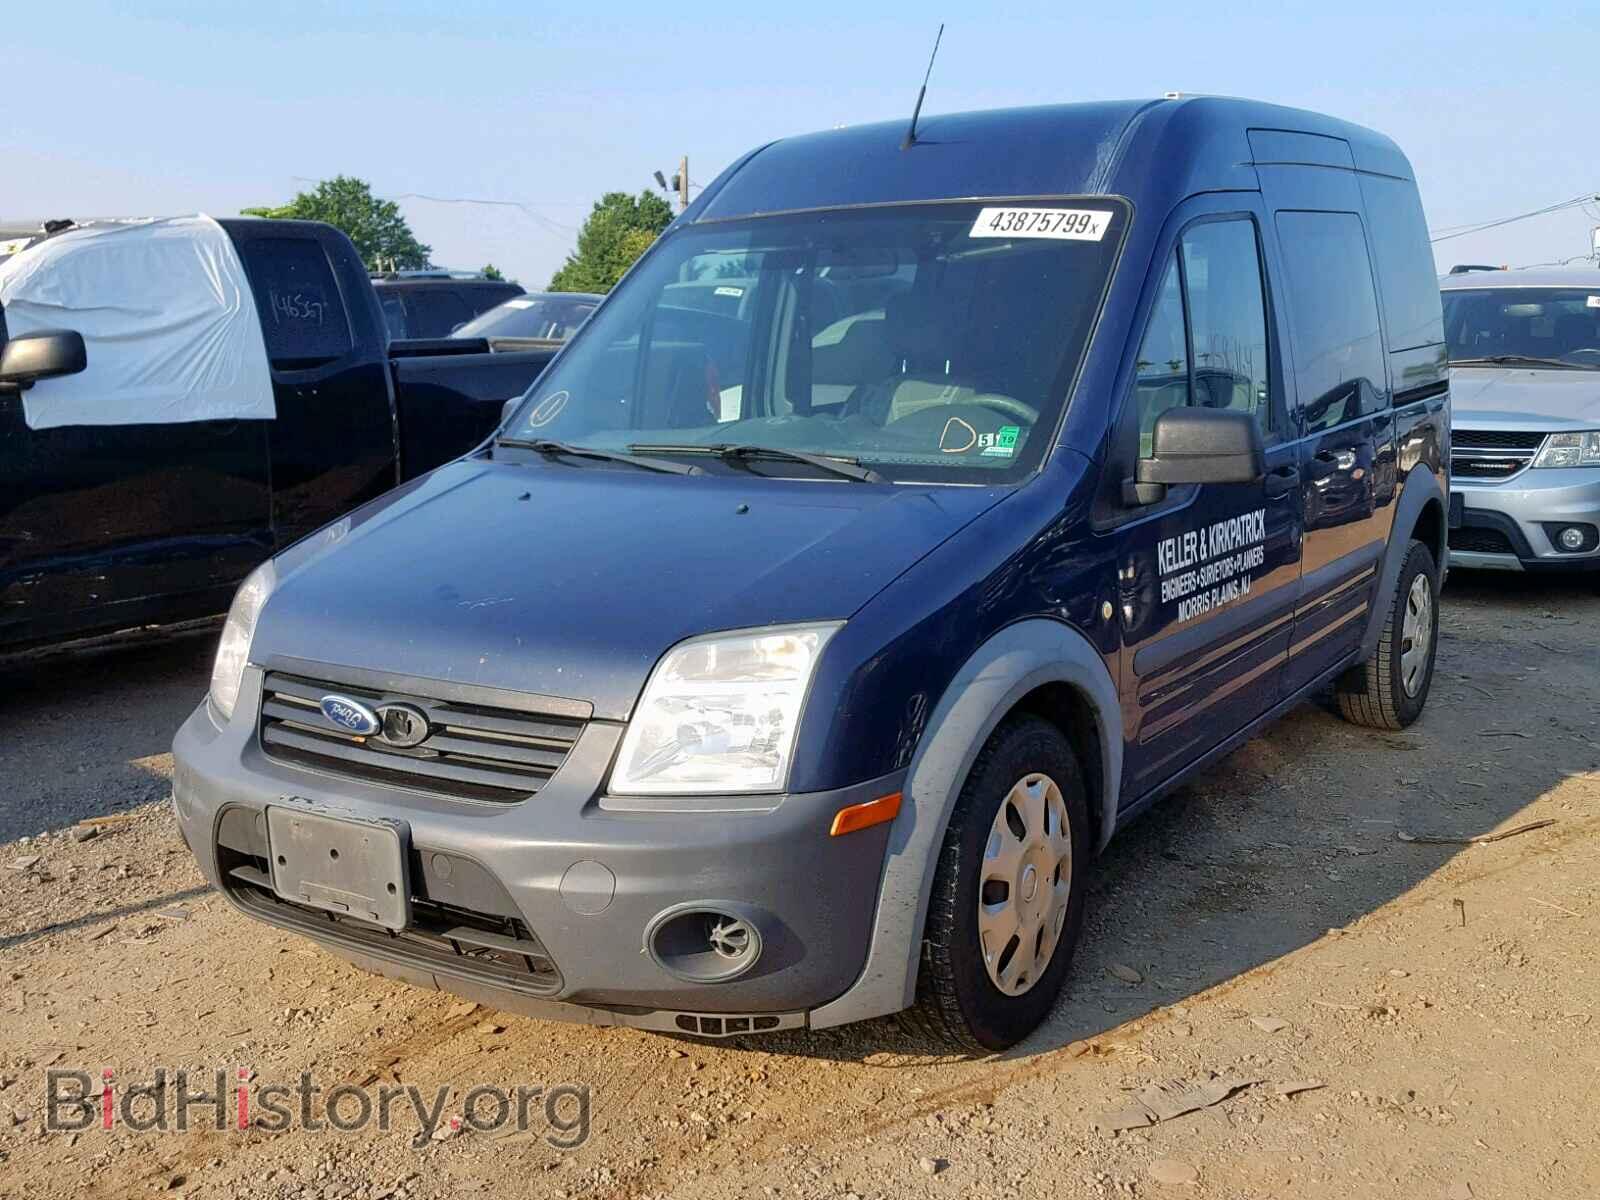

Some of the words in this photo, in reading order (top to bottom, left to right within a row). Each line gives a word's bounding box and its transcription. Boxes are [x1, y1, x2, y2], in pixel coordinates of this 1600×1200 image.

[1157, 530, 1199, 577] KELLER
[1199, 527, 1208, 561] &
[1208, 508, 1266, 558] KIRKPATRICK
[1178, 590, 1210, 623] MORRIS
[1211, 579, 1240, 610] PLAINS,
[1241, 573, 1252, 595] NJ
